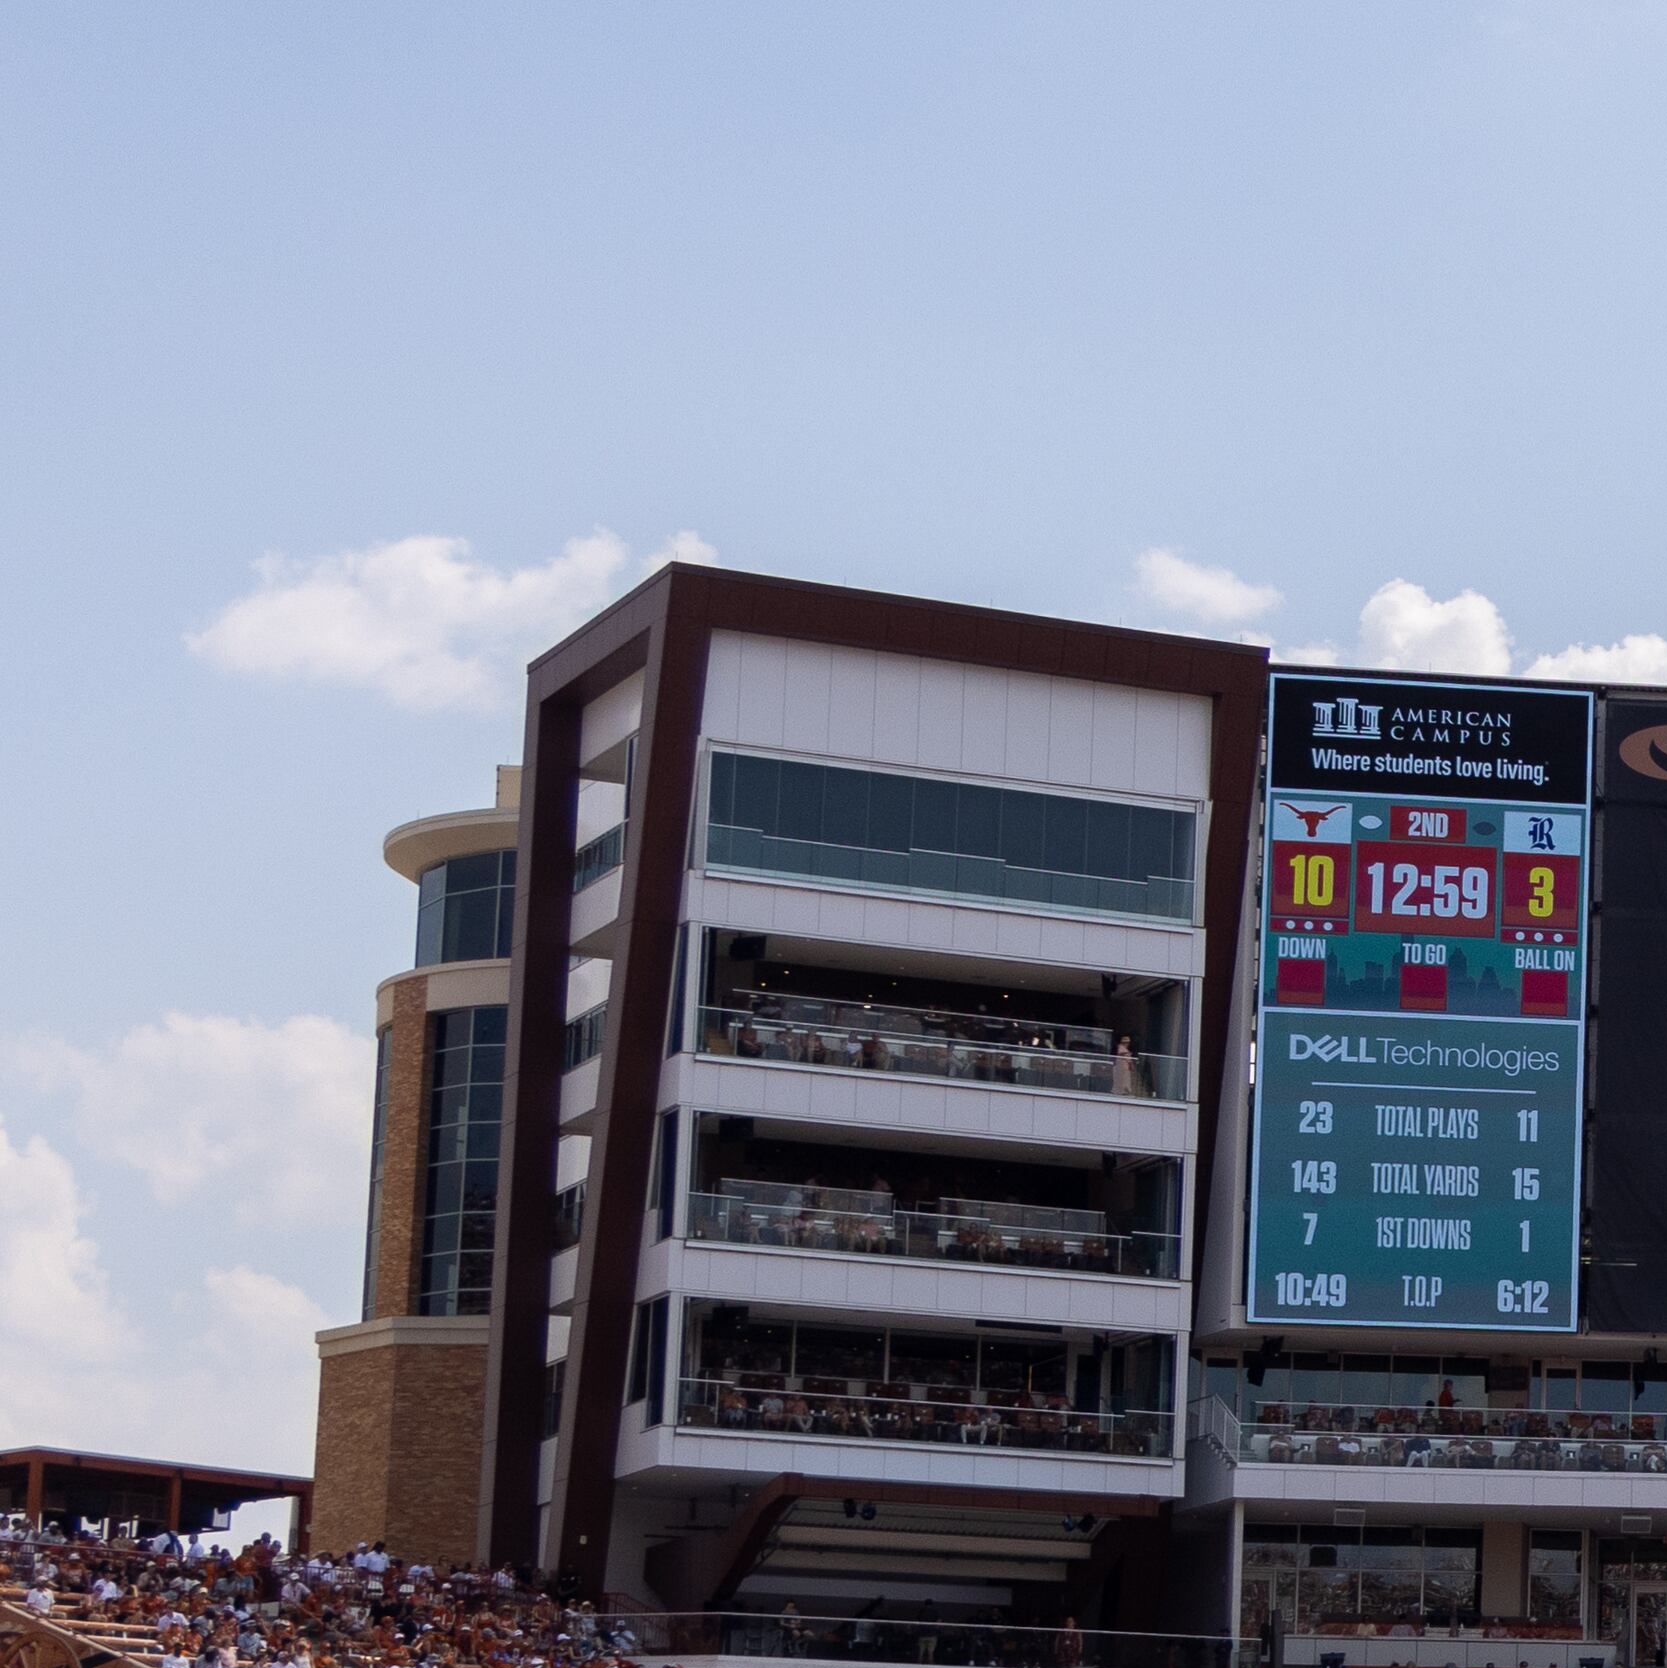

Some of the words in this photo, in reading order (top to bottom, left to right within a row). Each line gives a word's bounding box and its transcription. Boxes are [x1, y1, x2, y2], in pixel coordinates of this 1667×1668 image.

[1391, 707, 1512, 727] AMERICAN
[1391, 726, 1511, 747] CAMPUS
[1312, 748, 1371, 772] Where
[1375, 752, 1452, 776] students
[1456, 755, 1492, 777] love
[1496, 759, 1550, 785] living.
[1408, 811, 1449, 838] 2ND
[1290, 854, 1334, 906] 10
[1367, 862, 1489, 919] 12:59
[1528, 867, 1554, 918] 3
[1278, 937, 1326, 959] DOWN
[1402, 943, 1422, 964] TO
[1425, 944, 1446, 965] GO
[1515, 948, 1550, 970] BALL
[1554, 950, 1575, 971] ON
[1289, 1033, 1377, 1063] DELL
[1377, 1037, 1560, 1076] Technologies
[1299, 1101, 1334, 1133] 23
[1375, 1105, 1423, 1137] TOTAL
[1427, 1107, 1479, 1139] PLAYS
[1517, 1109, 1538, 1142] 11
[1291, 1160, 1337, 1193] 143
[1371, 1162, 1419, 1195] TOTAL
[1423, 1164, 1479, 1197] YARDS
[1512, 1168, 1540, 1200] 15
[1303, 1212, 1318, 1245] 7
[1376, 1216, 1404, 1248] 1ST
[1407, 1218, 1471, 1250] DOWNS
[1519, 1220, 1530, 1252] 1
[1275, 1272, 1347, 1306] 10:49
[1402, 1275, 1442, 1307] T.O.P
[1497, 1280, 1549, 1314] 6:12
